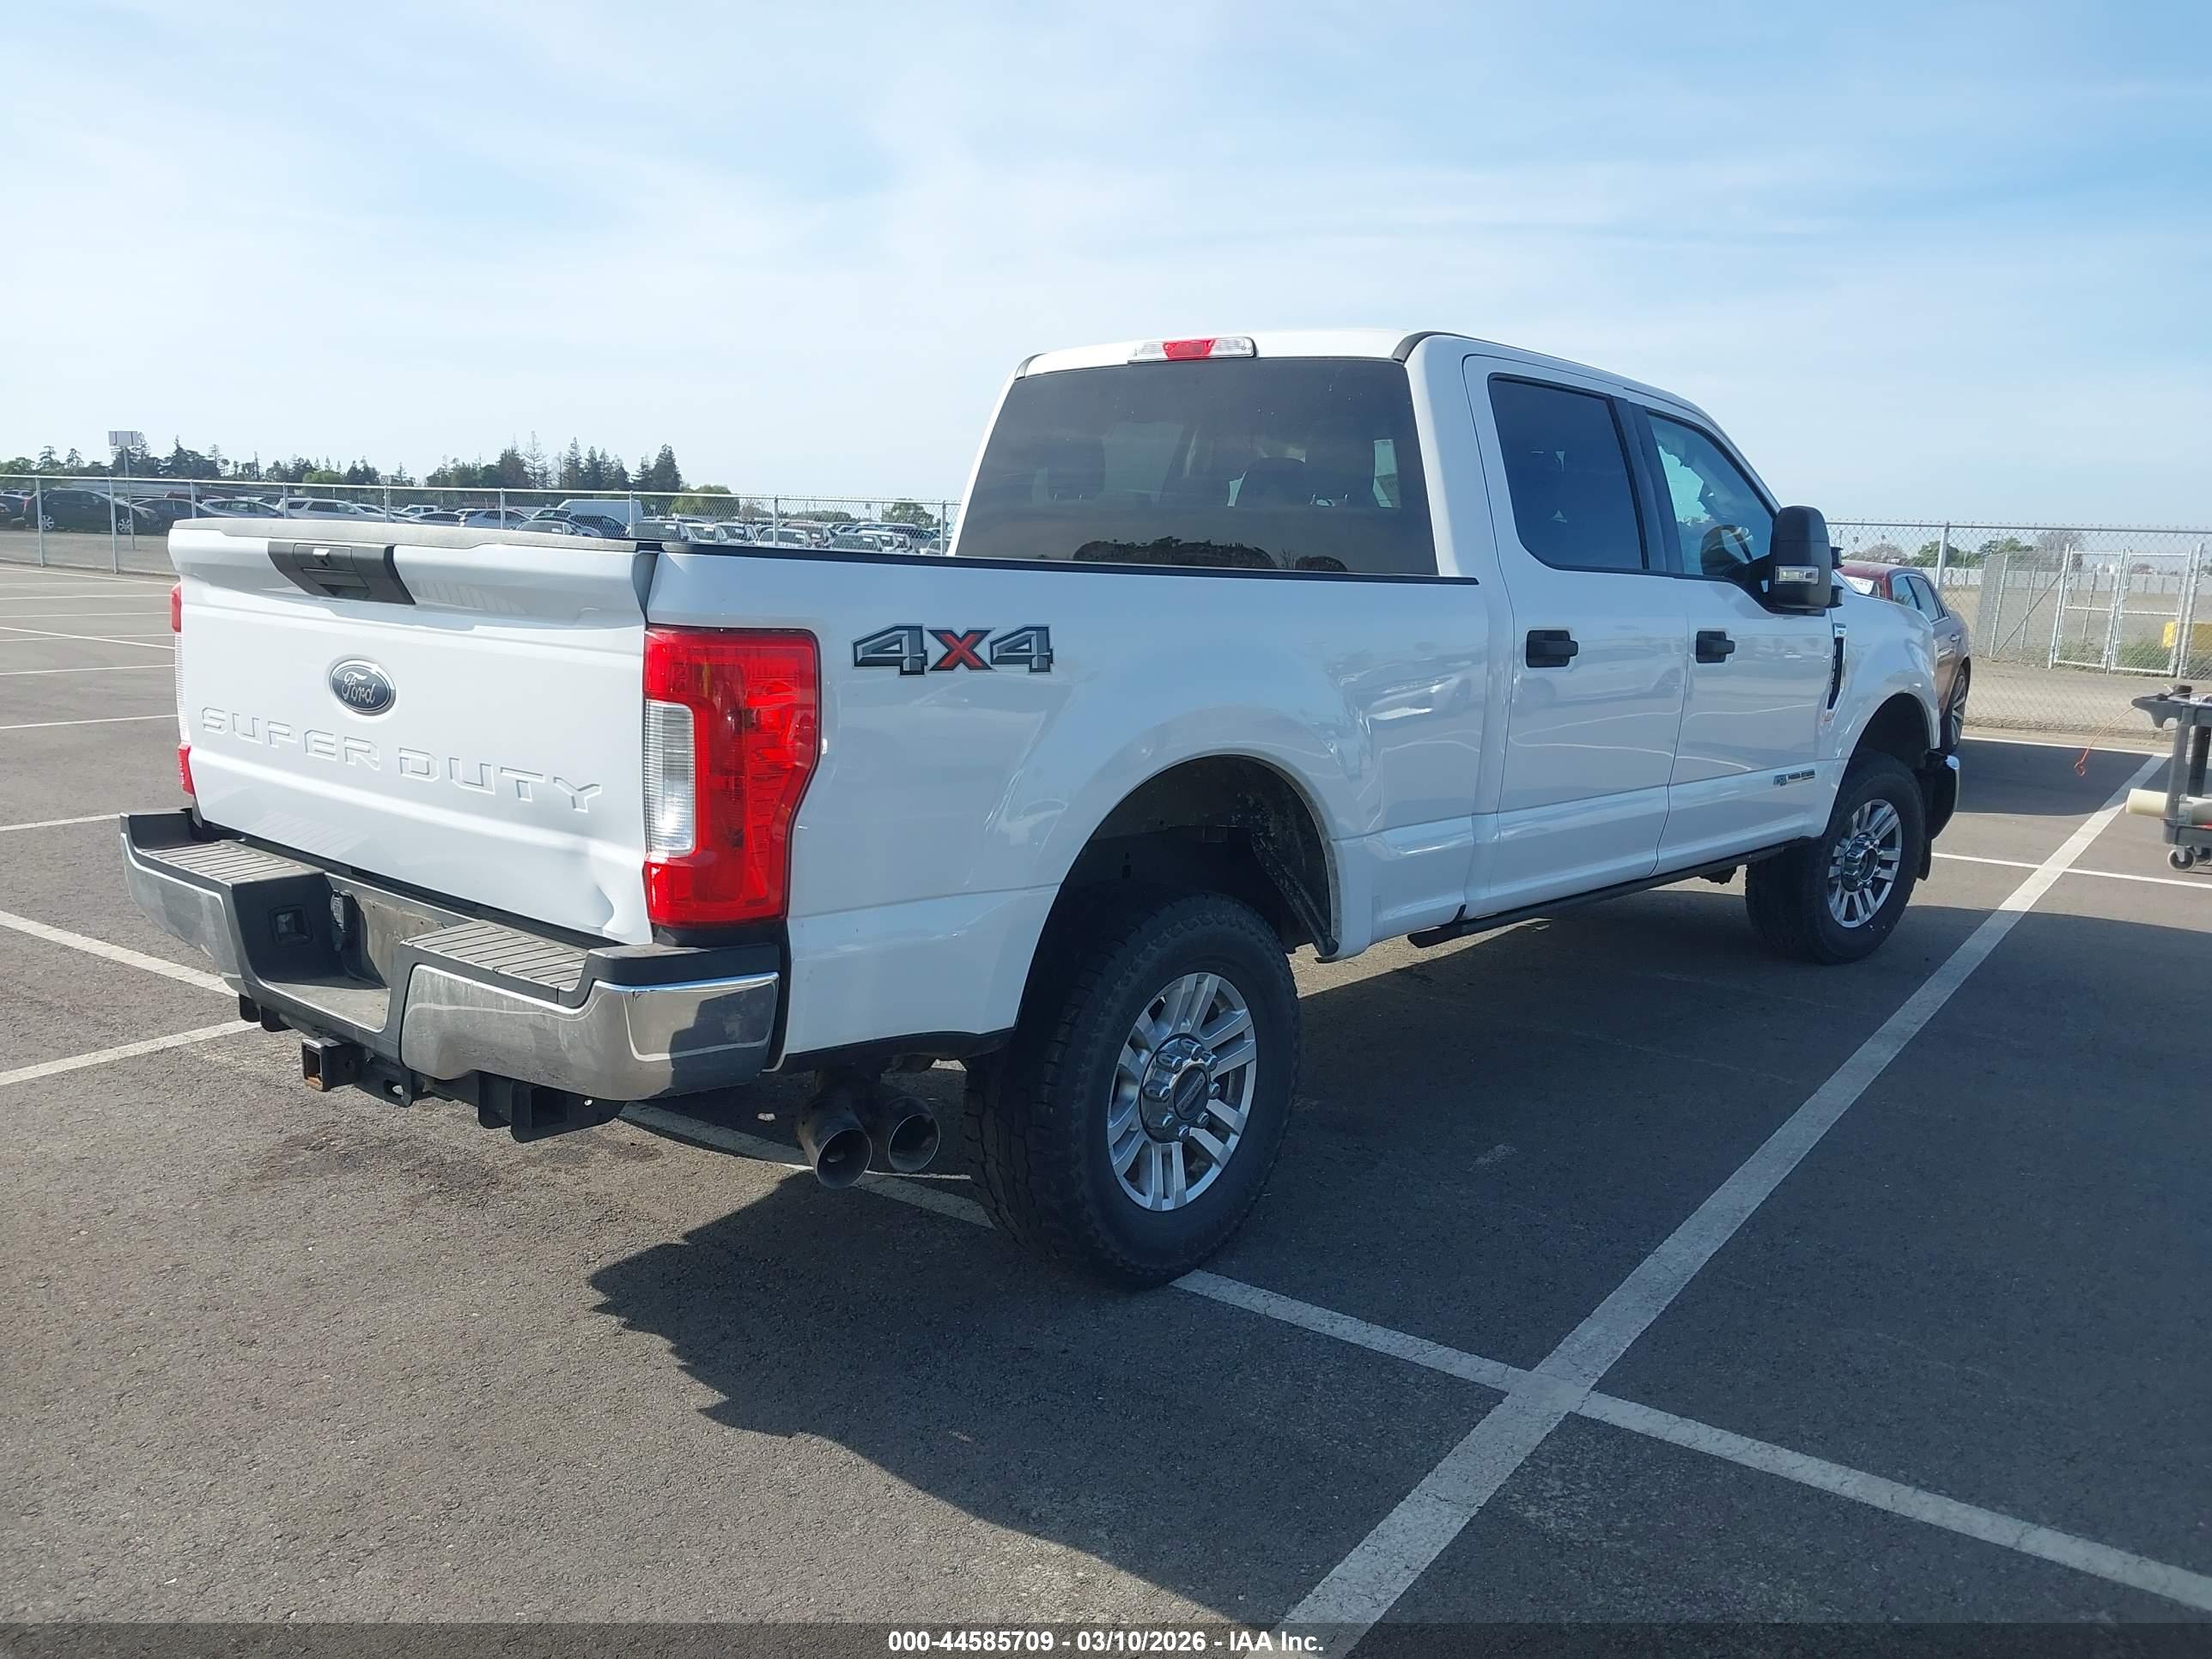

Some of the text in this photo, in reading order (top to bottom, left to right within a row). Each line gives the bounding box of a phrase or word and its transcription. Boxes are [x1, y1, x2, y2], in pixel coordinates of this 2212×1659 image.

[853, 623, 1054, 675] 4X4
[342, 671, 376, 704] Ford
[202, 708, 602, 813] SUPER DUTY
